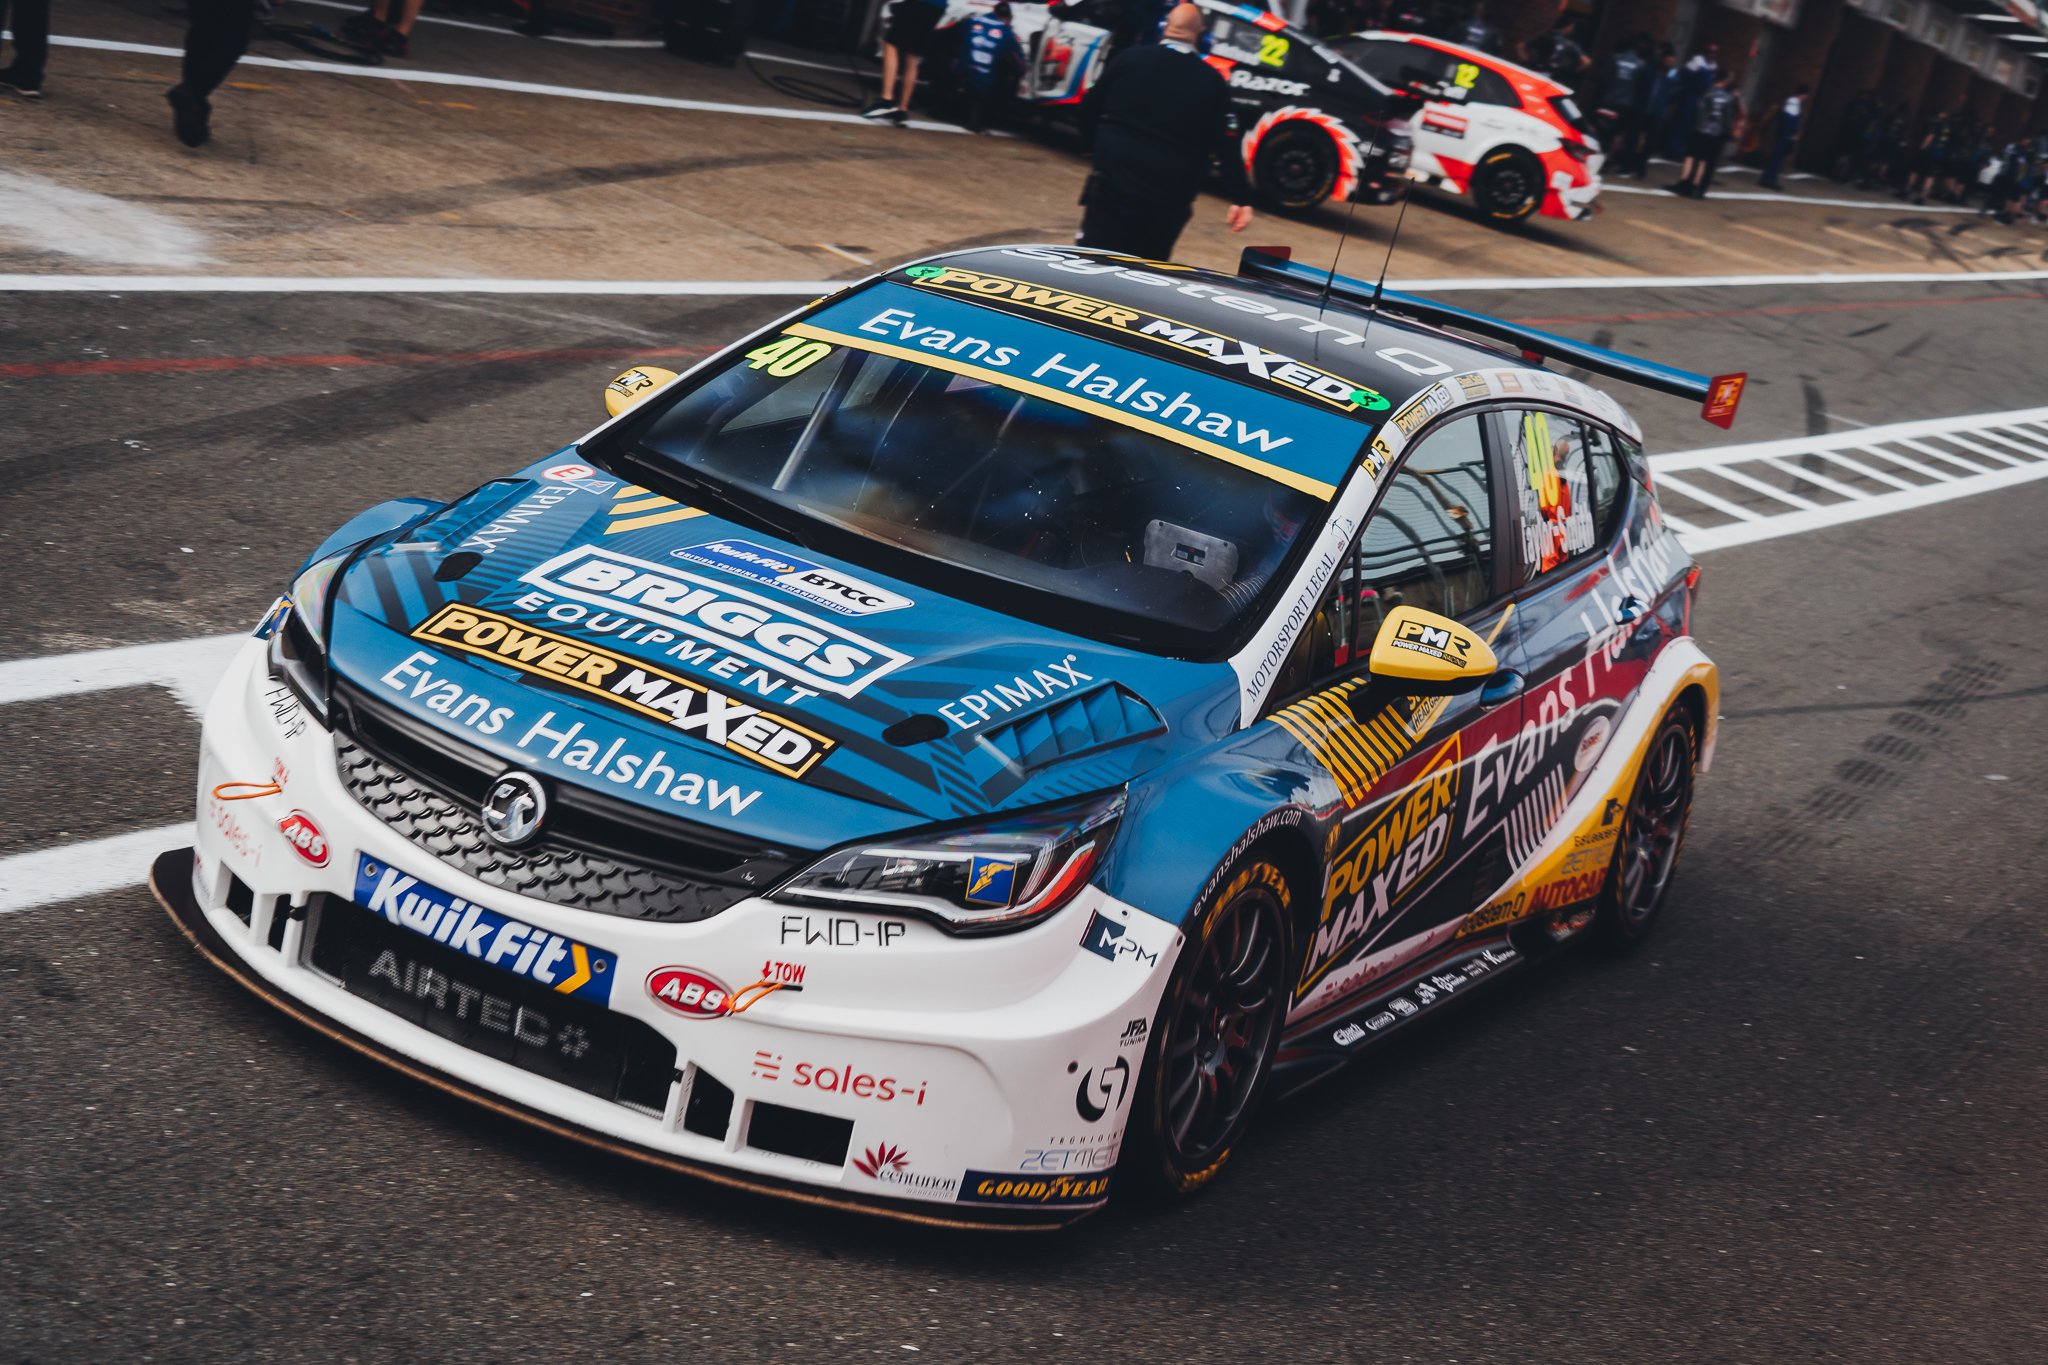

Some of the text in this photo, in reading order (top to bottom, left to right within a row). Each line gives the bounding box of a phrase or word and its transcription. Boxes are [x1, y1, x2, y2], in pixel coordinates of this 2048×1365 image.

[1260, 34, 1290, 67] 22
[1454, 62, 1481, 89] 12
[745, 336, 832, 378] 40
[939, 270, 1355, 402] POWER MAXED
[858, 308, 1294, 453] Evans Halshaw
[1400, 385, 1450, 435] POWER MAXED
[1363, 438, 1392, 480] PMR
[1524, 411, 1560, 508] 40
[461, 486, 579, 550] EPIMAX
[677, 551, 854, 614] BRITISH TOURING CAR CHAMPIONSHIP
[800, 573, 886, 607] BTCC
[513, 591, 821, 706] EQUIPMENT
[563, 558, 873, 677] BRIGGS
[1246, 552, 1336, 704] MOTORSPORT LEGAL
[1397, 621, 1472, 657] PMR
[1393, 640, 1466, 667] POWER MAXED RACING
[428, 611, 814, 766] POWER MAXED
[937, 657, 1094, 730] EPIMAX
[380, 650, 764, 817] Evans Halshaw
[1462, 665, 1576, 839] Evans
[283, 821, 325, 858] ABS
[1193, 809, 1302, 917] evanshalshaw.com
[1320, 758, 1454, 922] POWER
[1307, 812, 1448, 976] MAXED
[774, 962, 808, 984] TOW
[1098, 927, 1158, 967] MPM
[370, 949, 552, 1048] AIRTEC
[657, 977, 727, 1011] ABS
[1119, 1034, 1146, 1048] TUNING
[1120, 1016, 1148, 1038] JFA
[792, 1060, 928, 1106] sales-i
